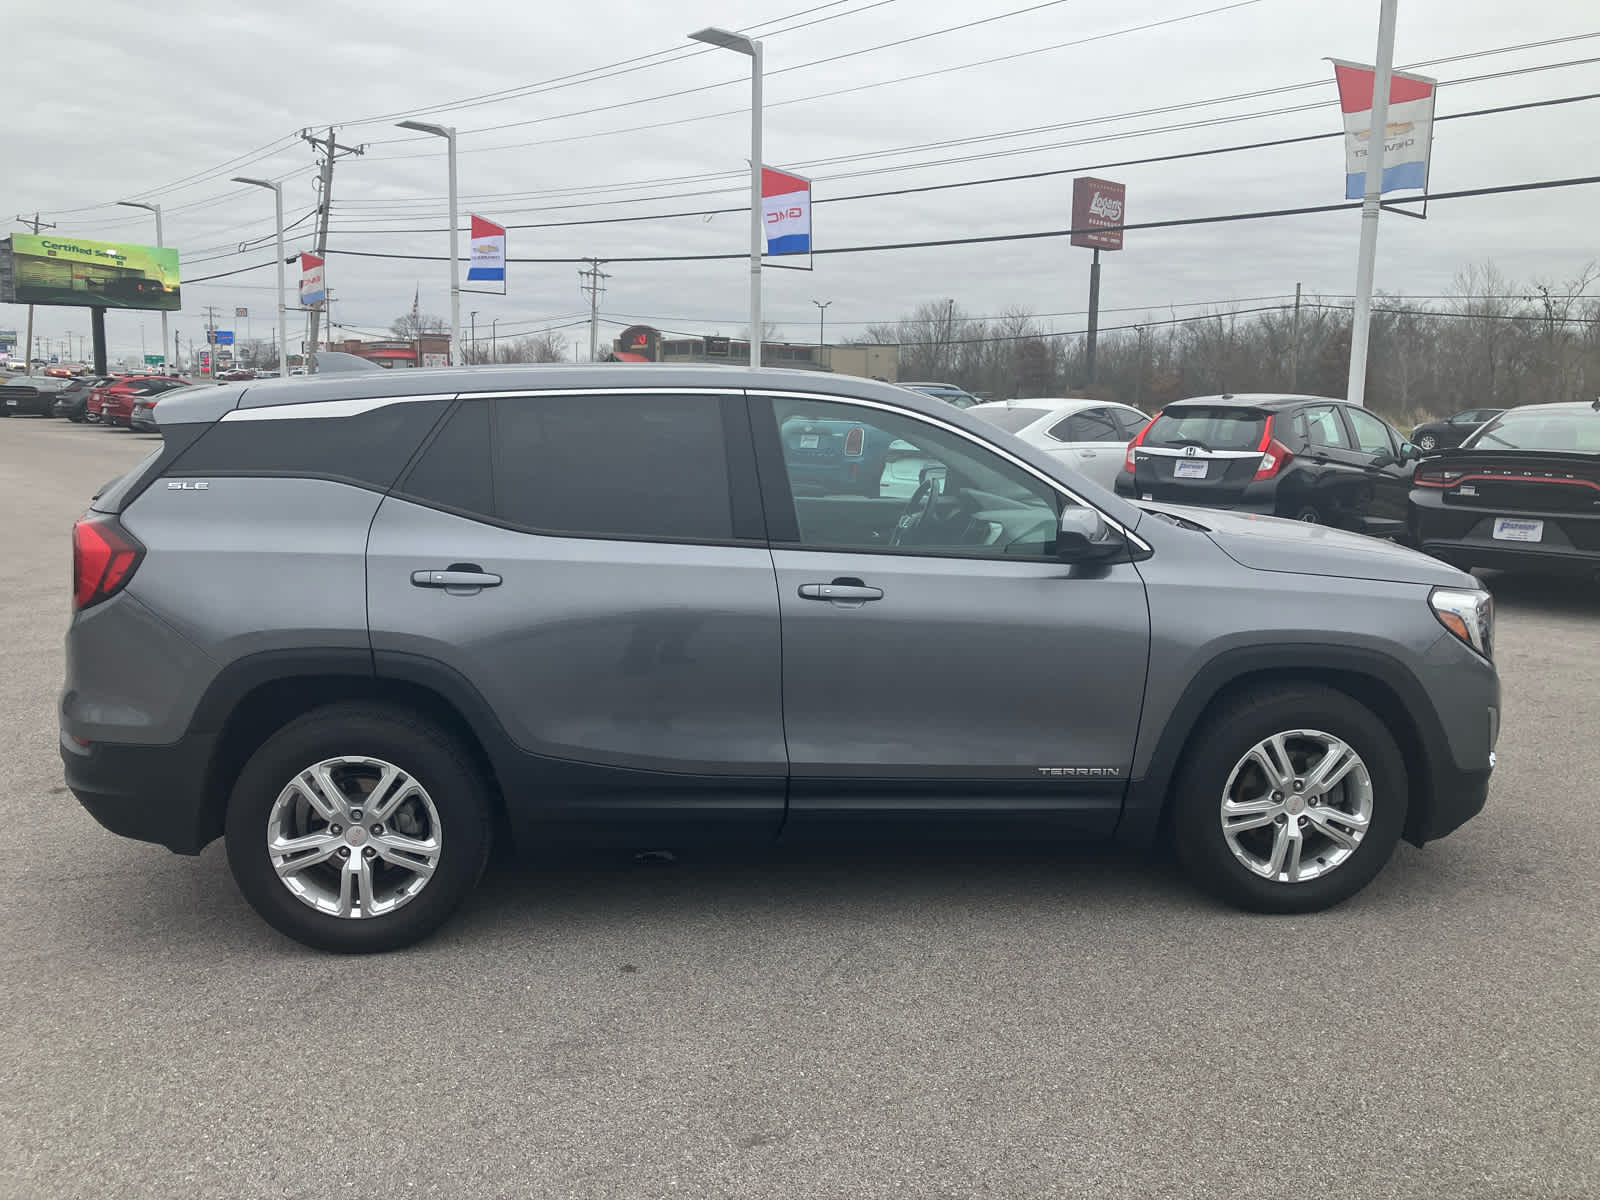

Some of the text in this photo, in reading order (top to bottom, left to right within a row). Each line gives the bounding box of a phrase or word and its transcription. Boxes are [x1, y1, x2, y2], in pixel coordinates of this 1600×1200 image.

[42, 240, 92, 256] Certified
[167, 482, 209, 490] SLE
[1038, 767, 1119, 776] TERRAIN
